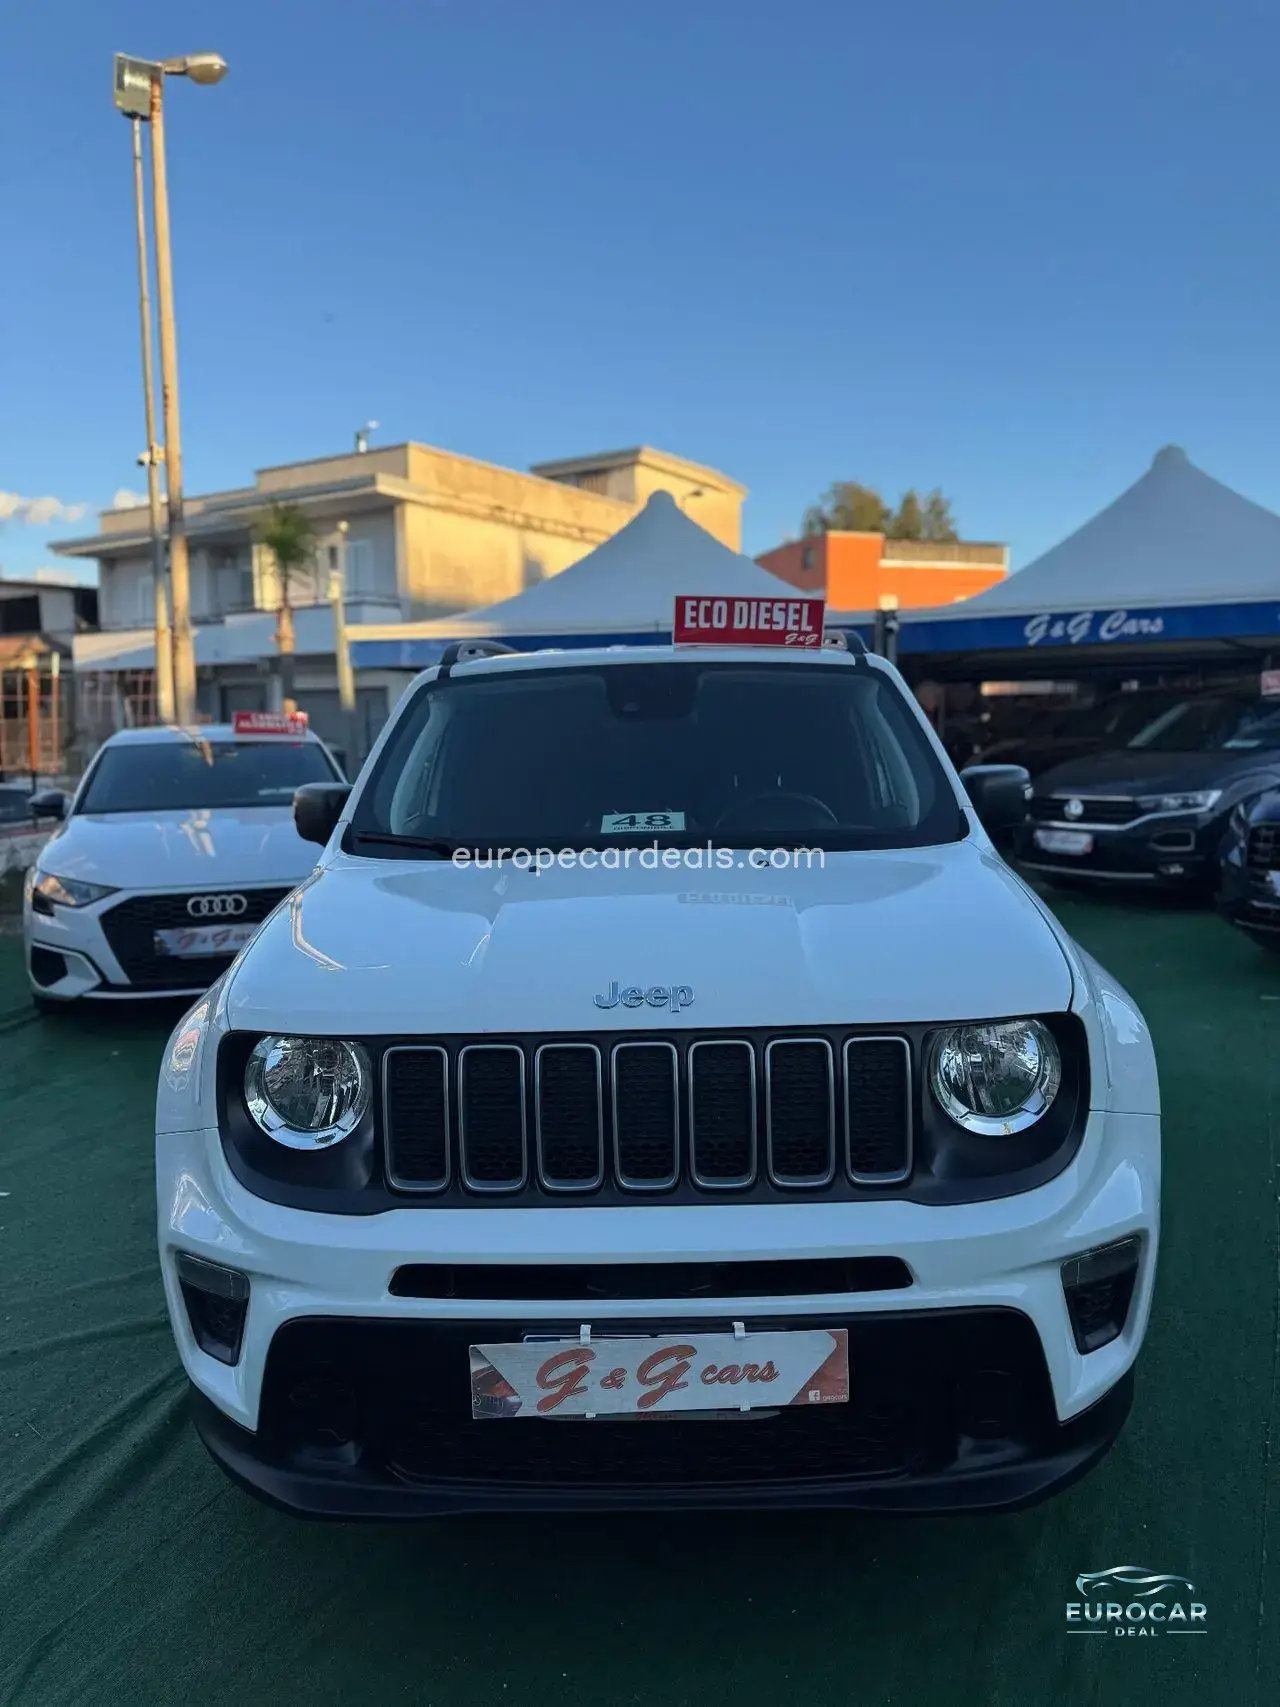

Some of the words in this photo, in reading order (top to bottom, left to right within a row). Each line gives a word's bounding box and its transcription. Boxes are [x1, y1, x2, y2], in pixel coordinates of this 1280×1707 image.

[684, 600, 727, 629] ECO
[733, 601, 813, 632] DIESEL
[1099, 610, 1165, 640] Cars
[612, 814, 672, 827] 48
[593, 980, 695, 1013] Jeep
[536, 1348, 597, 1413] G
[636, 1344, 698, 1409] G
[700, 1360, 781, 1386] cars
